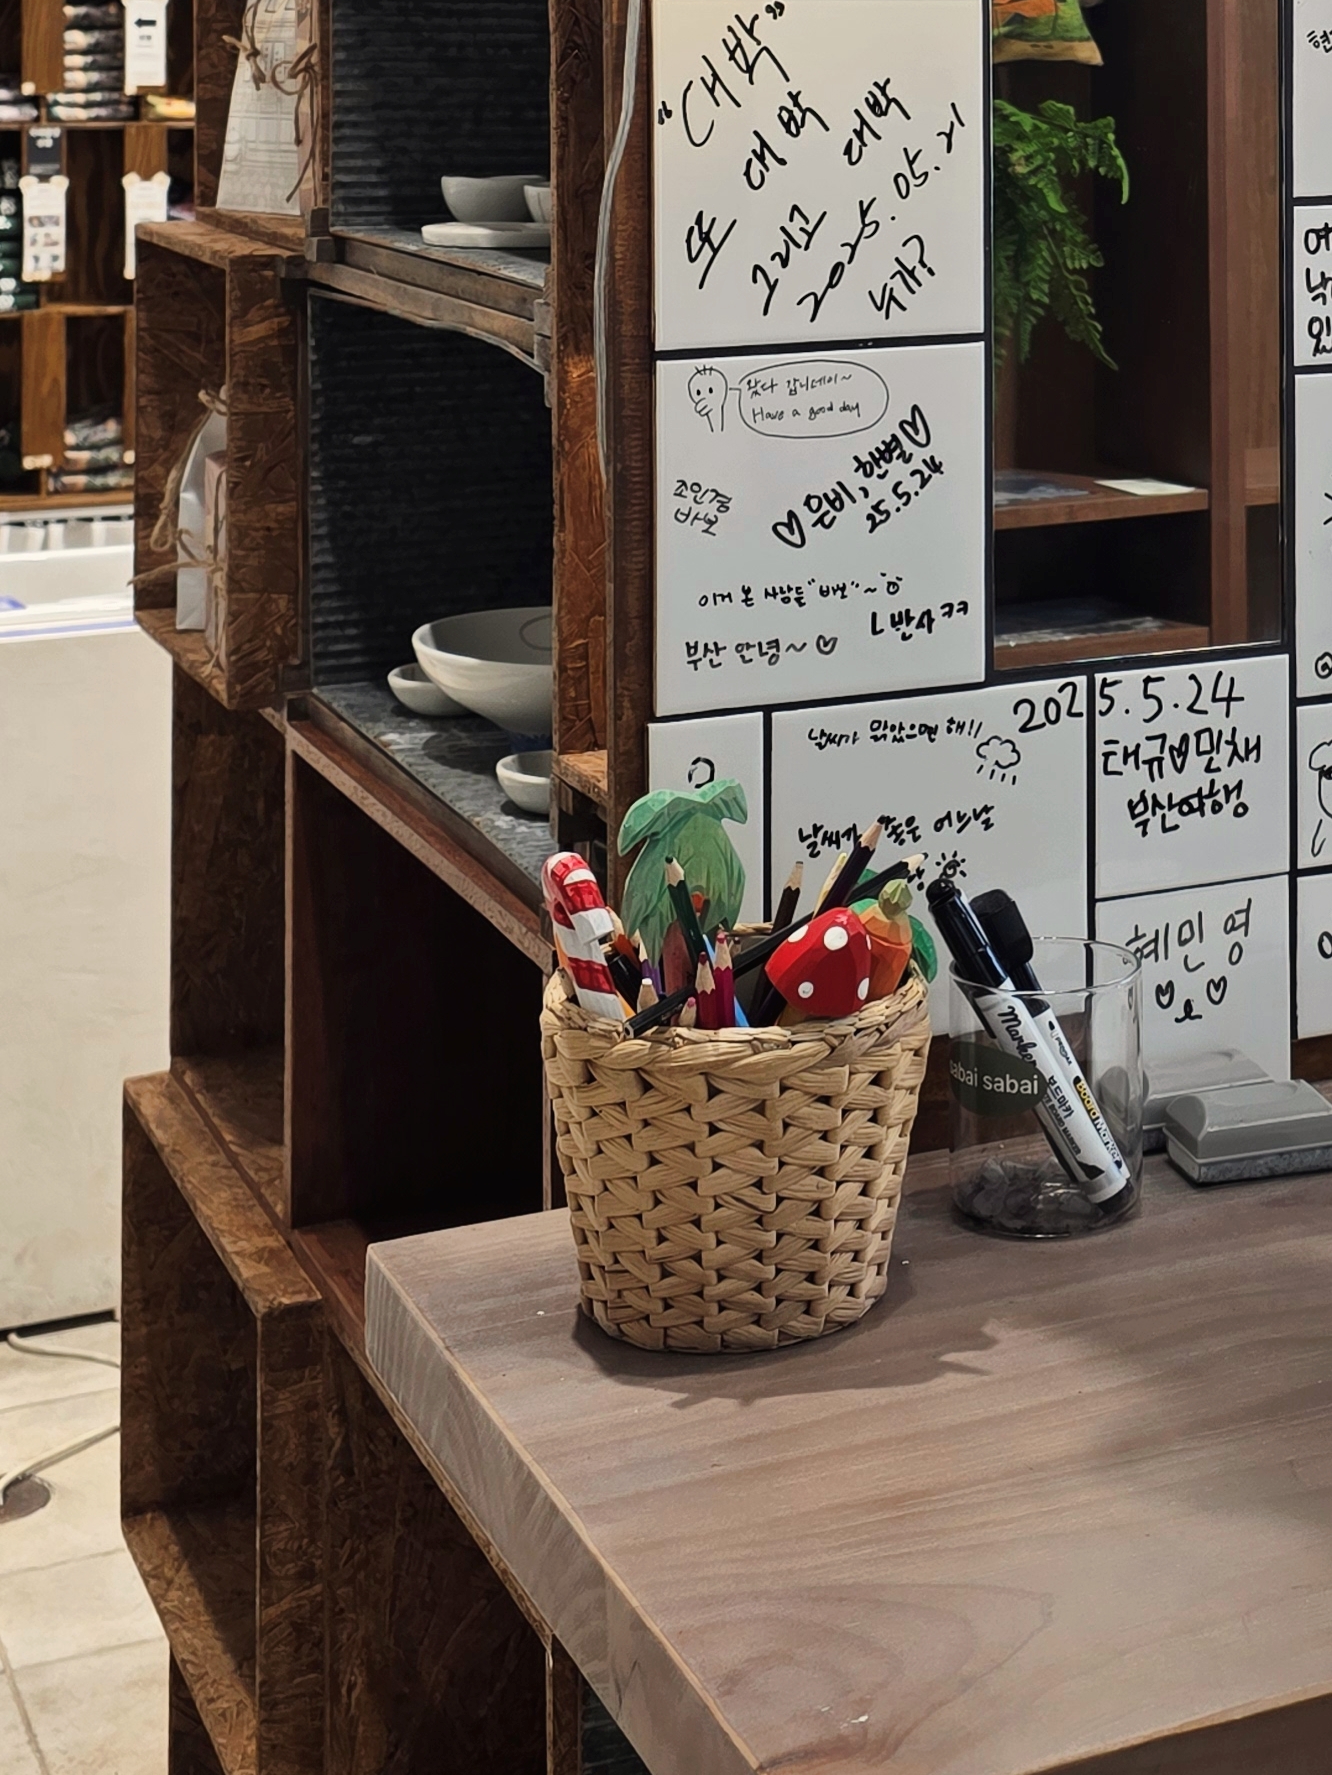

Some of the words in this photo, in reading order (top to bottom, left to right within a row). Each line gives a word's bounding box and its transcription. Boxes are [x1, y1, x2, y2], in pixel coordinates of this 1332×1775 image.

[742, 89, 831, 192] 대박
[843, 76, 912, 167] 대박
[751, 404, 786, 425] Have
[790, 407, 803, 418] a
[807, 400, 836, 422] good
[837, 398, 862, 419] day
[864, 454, 945, 535] 25.5.24
[740, 583, 755, 608] 본
[685, 639, 728, 672] 부산
[1193, 725, 1262, 774] 민채
[982, 1073, 1040, 1096] sabai
[1074, 1076, 1100, 1118] Board
